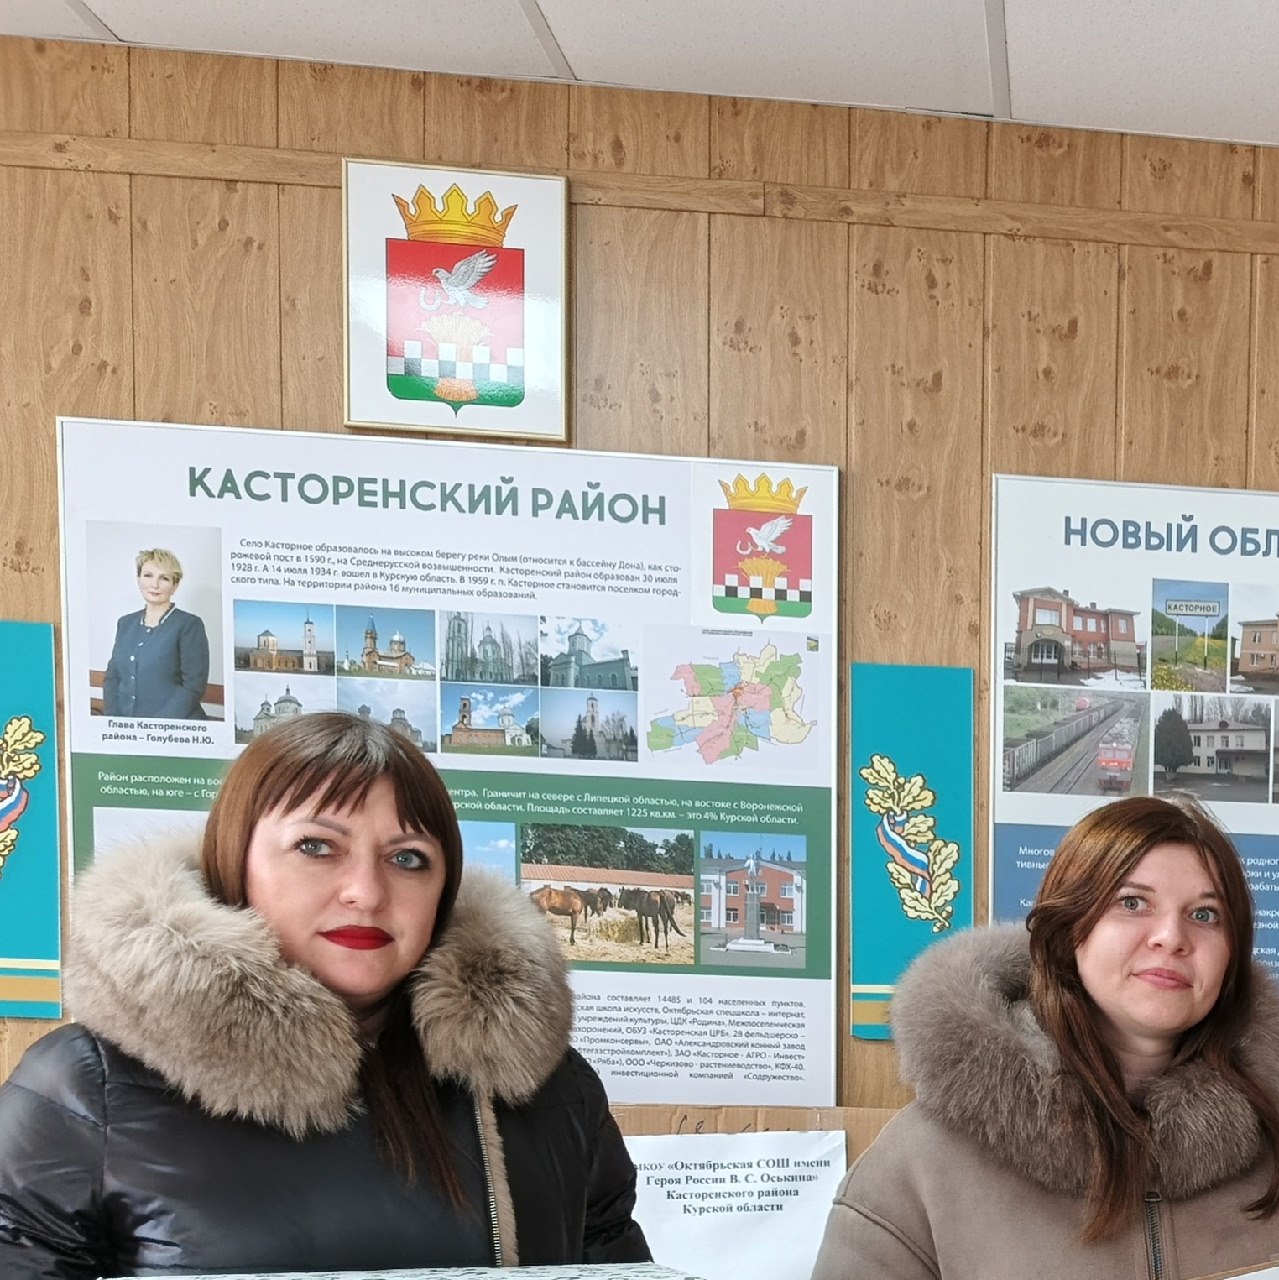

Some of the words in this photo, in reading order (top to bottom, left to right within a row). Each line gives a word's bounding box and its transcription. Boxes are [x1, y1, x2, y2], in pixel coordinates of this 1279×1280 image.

[189, 466, 518, 516] КАСТОРЕНСКИЙ
[532, 482, 665, 525] РАЙОН
[1064, 514, 1198, 552] НОВЫЙ
[240, 539, 263, 548] Село
[265, 541, 313, 552] Касторное
[316, 543, 378, 554] образовалось
[436, 550, 466, 562] берегу
[468, 554, 489, 563] реки
[274, 554, 294, 562] пост
[305, 555, 325, 564] 1590
[350, 557, 420, 569] Среднерусской
[500, 566, 561, 578] Касторенский
[564, 570, 592, 579] район
[594, 570, 639, 582] образован
[262, 564, 269, 572] А
[311, 567, 331, 576] 1934
[341, 570, 370, 578] вошел
[380, 571, 417, 582] Курскую
[420, 574, 457, 583] область.
[468, 576, 488, 584] 1959
[508, 579, 555, 589] Касторное
[557, 582, 605, 591] становится
[608, 585, 650, 594] поселком
[231, 576, 256, 584] ского
[284, 578, 295, 586] На
[298, 580, 352, 592] территории
[354, 583, 387, 592] района
[390, 584, 399, 592] 16
[402, 585, 474, 598] муниципальных
[1168, 604, 1217, 612] КАСТОРНОЕ
[108, 721, 134, 730] Глава
[137, 721, 206, 733] Касторенского
[102, 733, 137, 742] района
[147, 734, 190, 744] Голубева
[98, 771, 128, 782] Район
[130, 774, 191, 786] расположен
[194, 777, 205, 785] на
[100, 785, 149, 796] областью,
[166, 790, 184, 798] юге
[483, 788, 526, 798] Граничит
[542, 793, 575, 802] севере
[584, 793, 630, 805] Липецкой
[632, 796, 679, 807] областью,
[741, 802, 803, 812] Воронежской
[485, 803, 525, 811] области.
[527, 803, 570, 814] Площадь
[572, 807, 623, 815] составляет
[627, 808, 648, 817] 1225
[704, 812, 718, 820] 4%
[720, 812, 757, 823] Курской
[760, 815, 799, 824] области.
[667, 1160, 753, 1173] «Октябрьская
[757, 1158, 789, 1169] СОШ
[646, 1176, 681, 1187] Героя
[686, 1175, 725, 1185] России
[730, 1175, 740, 1183] В.
[744, 1174, 756, 1183] С.
[760, 1172, 818, 1183] Оськина»
[667, 1190, 754, 1203] Касторенского
[758, 1188, 799, 1199] района
[683, 1205, 732, 1215] Курской
[737, 1203, 782, 1212] области
